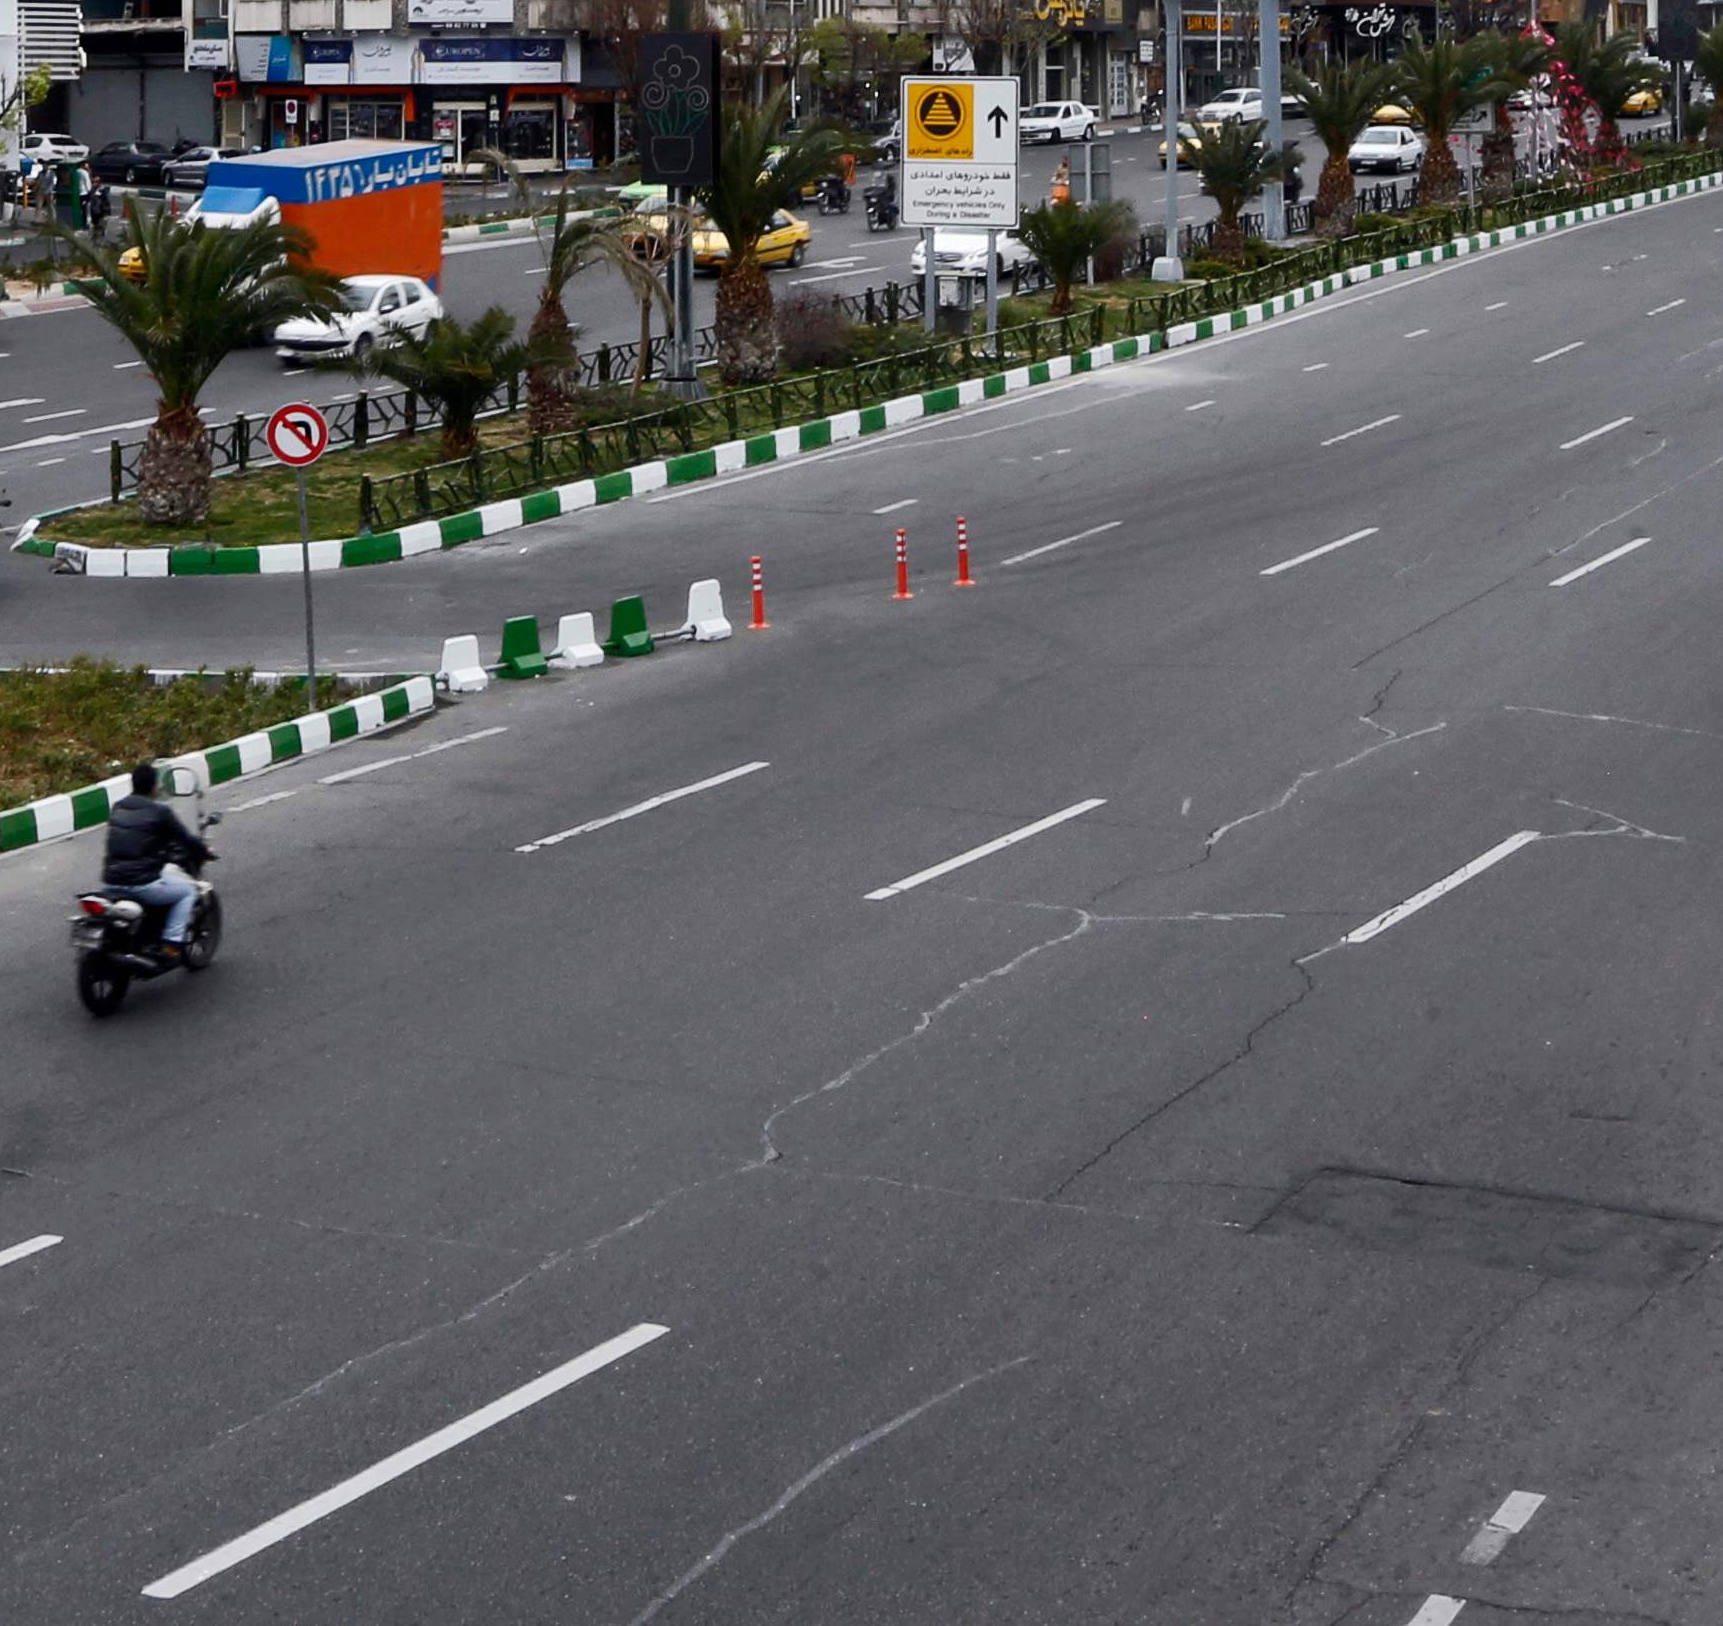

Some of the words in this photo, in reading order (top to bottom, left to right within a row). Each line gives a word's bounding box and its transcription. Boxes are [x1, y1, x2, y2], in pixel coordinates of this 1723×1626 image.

[912, 200, 954, 209] Emergency
[926, 210, 951, 219] During
[960, 211, 991, 219] Disaster
